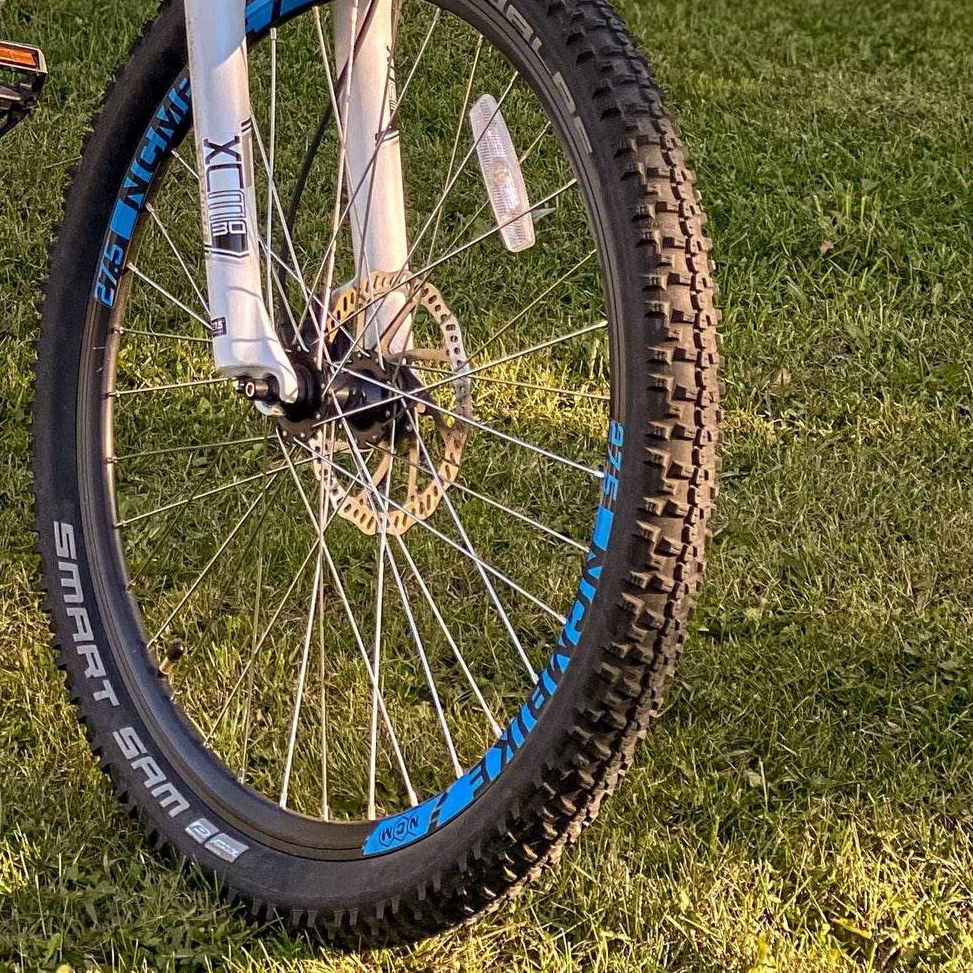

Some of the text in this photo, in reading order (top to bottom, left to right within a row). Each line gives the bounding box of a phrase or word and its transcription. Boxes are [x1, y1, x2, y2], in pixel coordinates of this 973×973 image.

[204, 135, 247, 222] XCM
[94, 239, 125, 308] 27.5
[602, 420, 625, 502] 275
[53, 521, 120, 707] SMART
[113, 727, 190, 818] SAM
[379, 816, 420, 847] NCM
